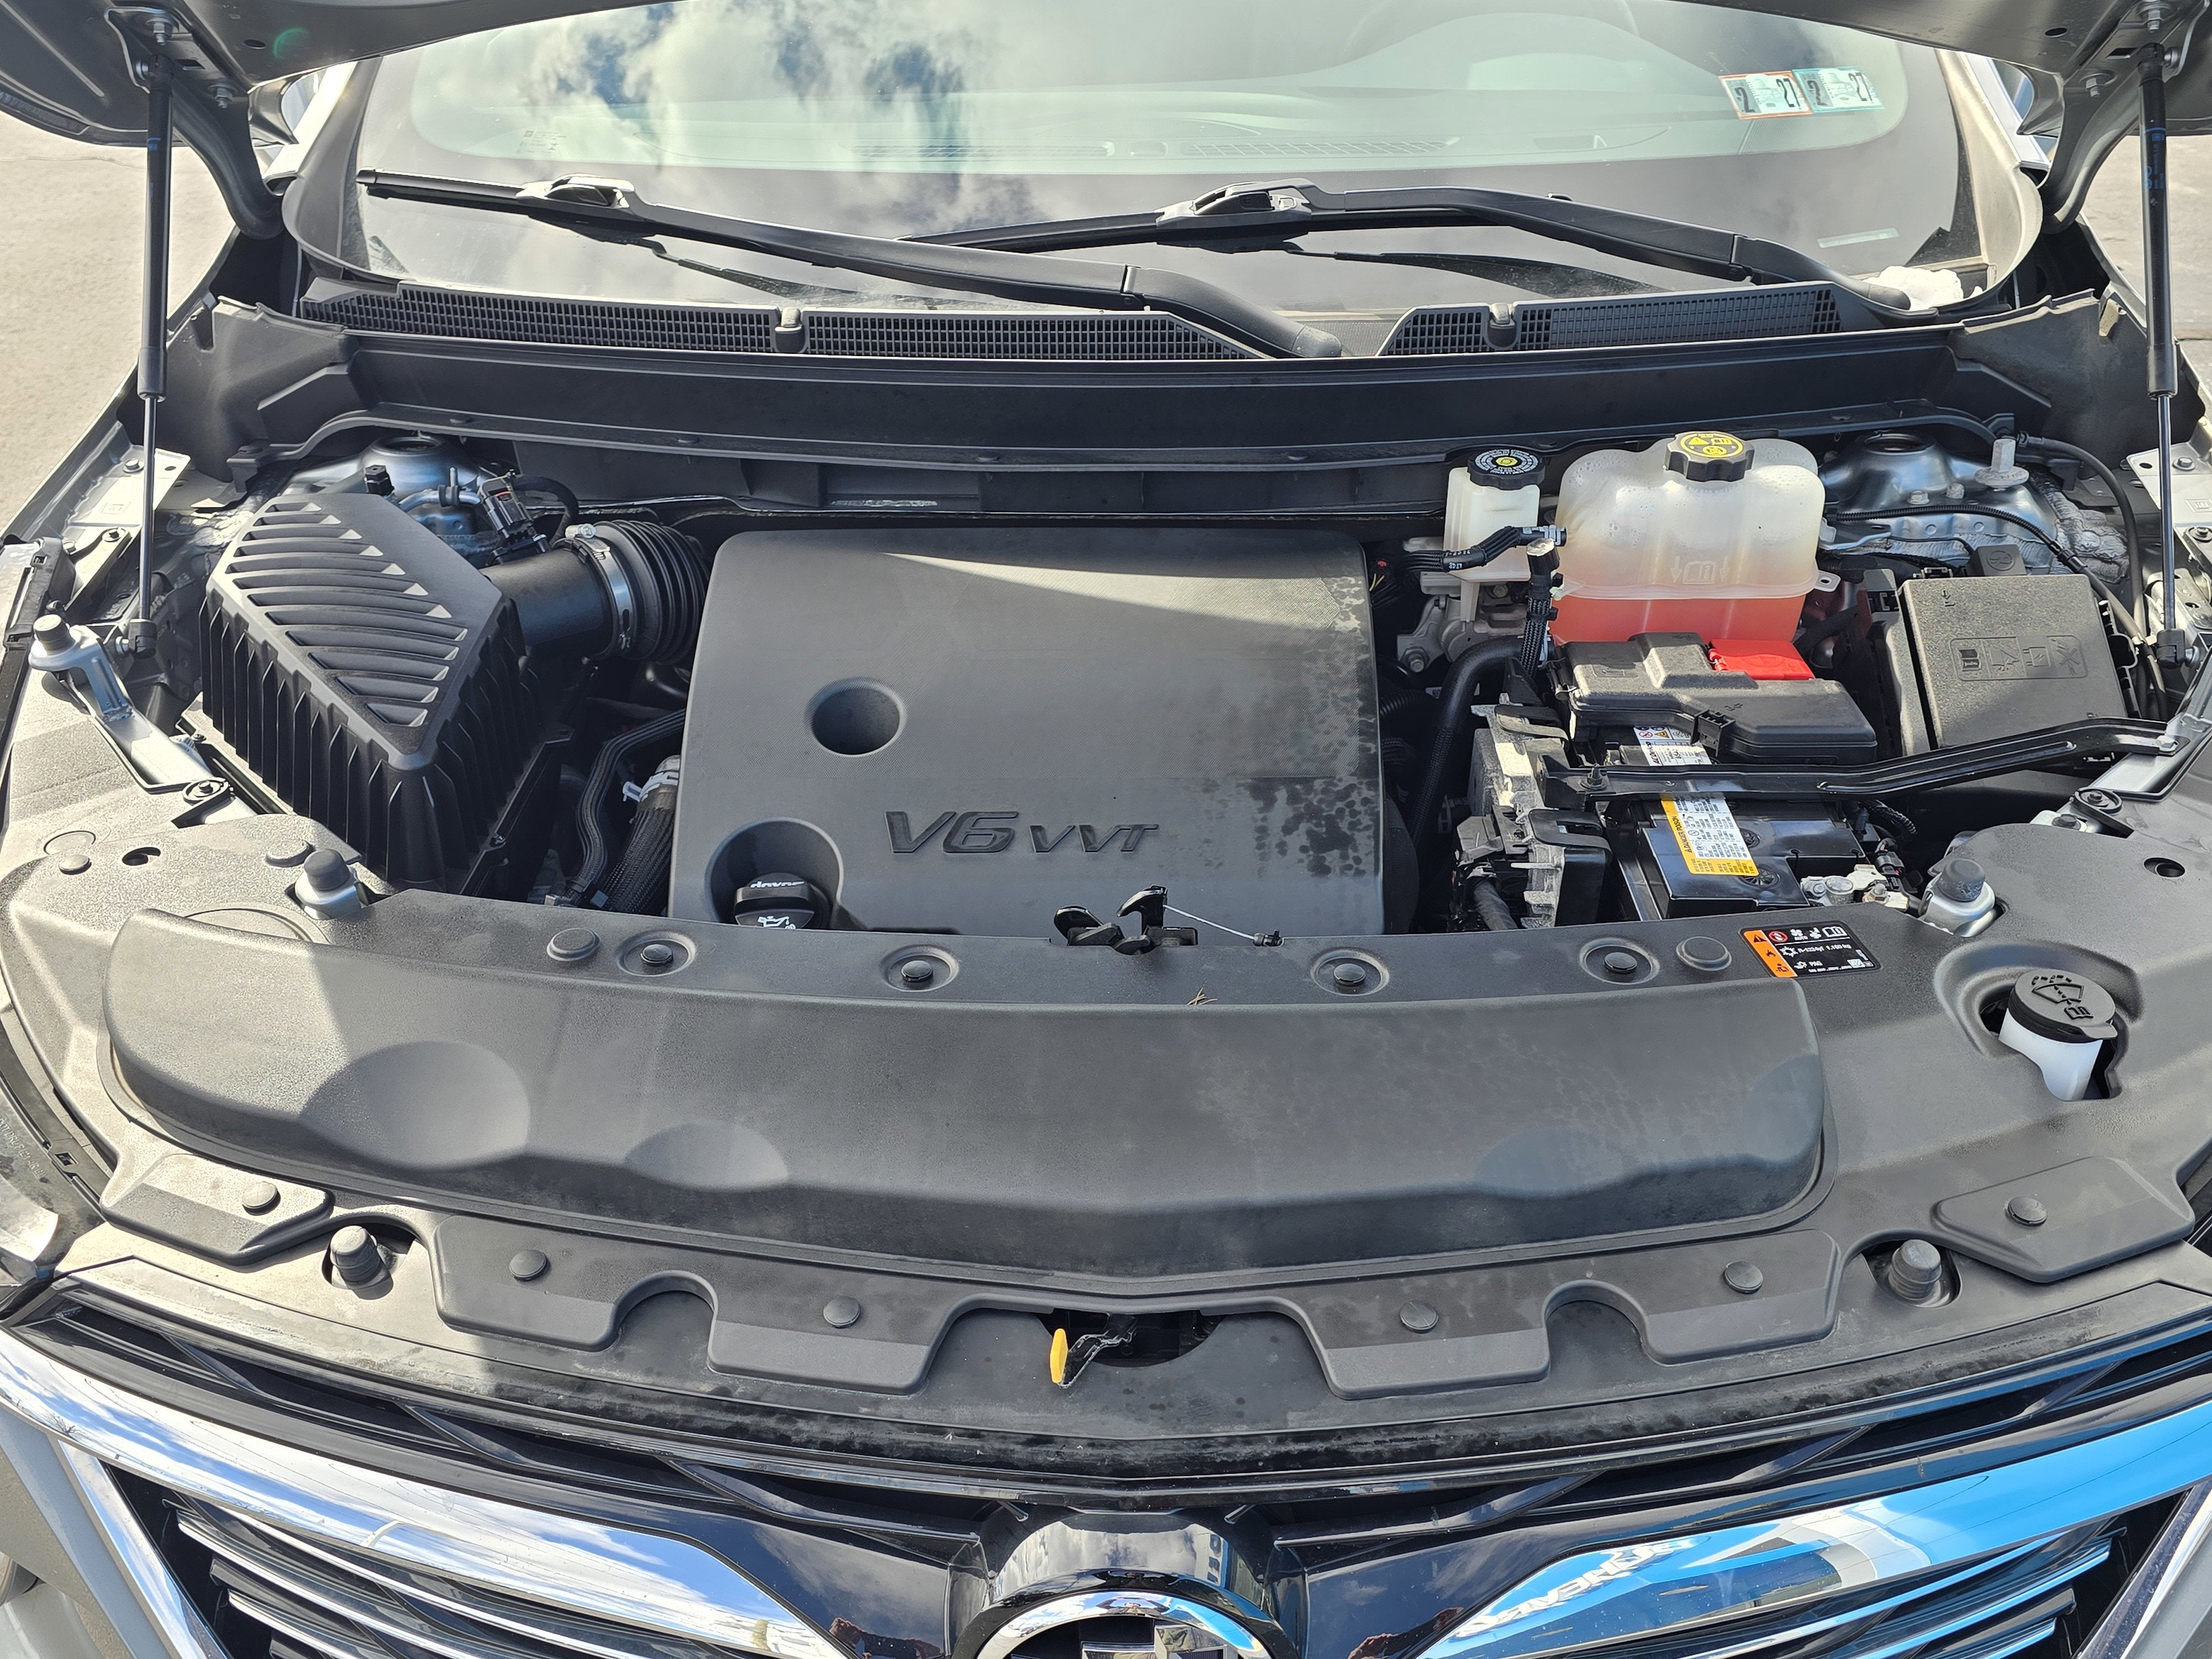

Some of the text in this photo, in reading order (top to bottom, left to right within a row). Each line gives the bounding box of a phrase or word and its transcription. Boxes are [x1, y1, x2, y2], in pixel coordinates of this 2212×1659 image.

[1734, 78, 1800, 113] 2 27
[1807, 72, 1872, 106] 2 27
[885, 811, 1159, 854] V6 VVT
[1671, 816, 1683, 831] POISON
